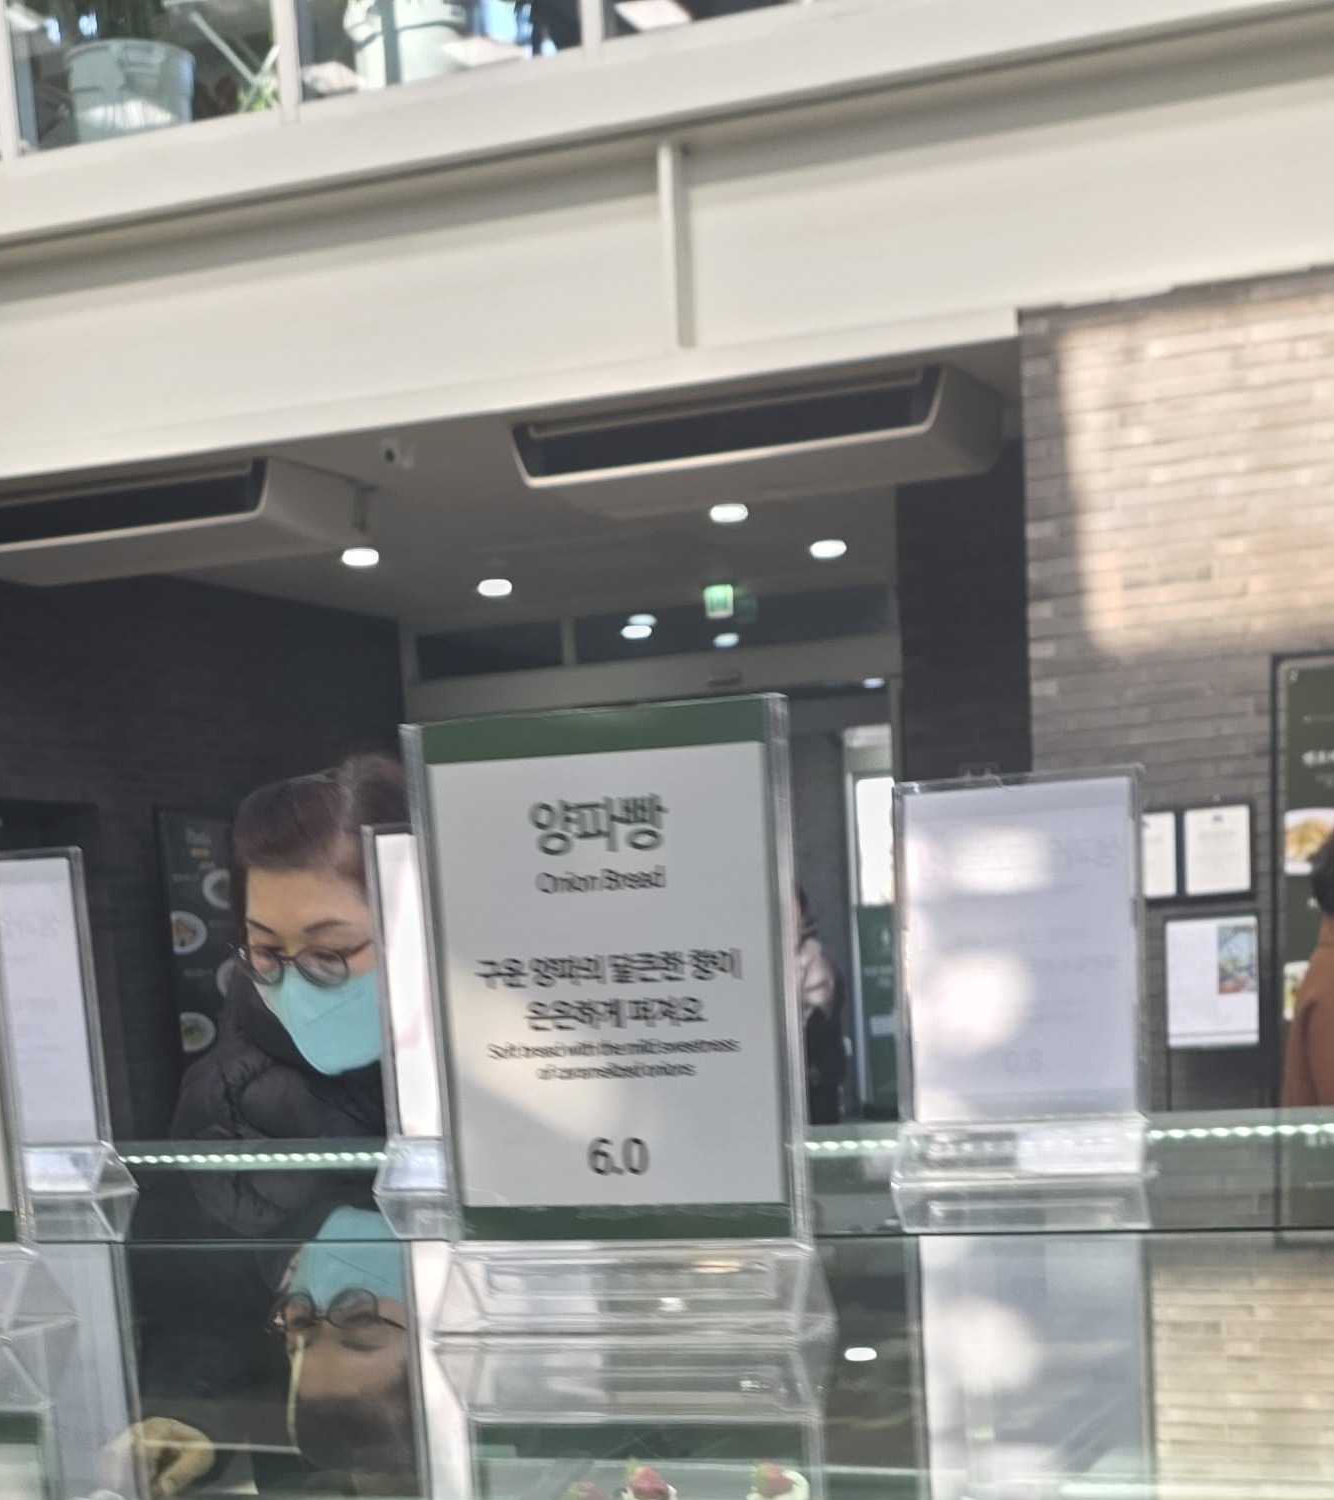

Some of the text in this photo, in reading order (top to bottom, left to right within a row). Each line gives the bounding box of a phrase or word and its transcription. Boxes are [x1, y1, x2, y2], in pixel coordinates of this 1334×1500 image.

[528, 792, 669, 857] 양파빵
[535, 864, 667, 894] Onion Bread
[475, 957, 529, 990] 구운
[528, 953, 607, 988] 양파의
[524, 998, 627, 1032] 은은하게
[587, 1136, 650, 1176] 6.0
